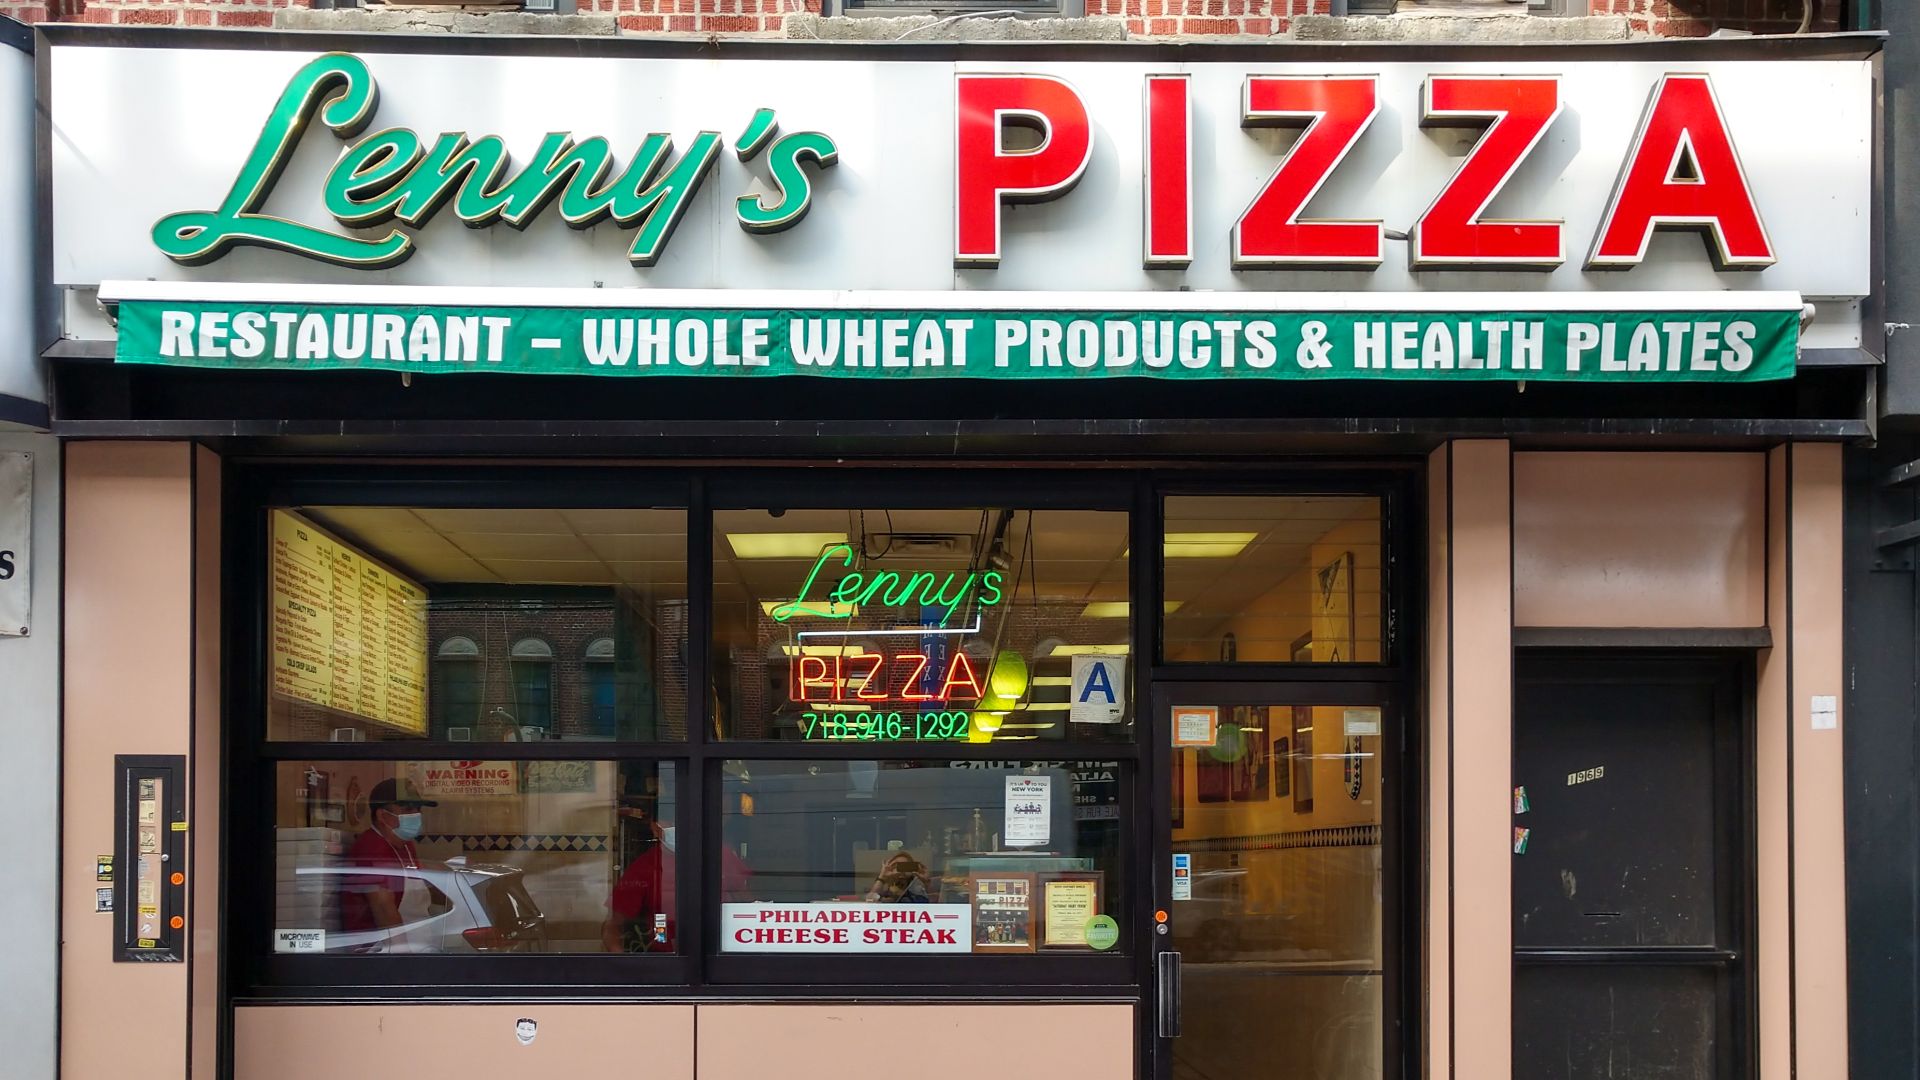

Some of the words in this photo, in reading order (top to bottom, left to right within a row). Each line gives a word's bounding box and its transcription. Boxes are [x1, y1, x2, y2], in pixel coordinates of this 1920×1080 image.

[149, 51, 839, 270] Lenny's
[953, 70, 1778, 268] PIZZA
[158, 310, 512, 363] RESTAURANT
[581, 317, 771, 367] WHOLE
[789, 318, 974, 367] WHEAT
[994, 318, 1278, 369] PRODUCTS
[1296, 320, 1334, 369] &
[1353, 320, 1545, 370] HEALTH
[1566, 320, 1757, 372] PLATES
[799, 652, 984, 700] PIZZA
[1079, 661, 1116, 704] A
[802, 711, 968, 740] 718-946-1292
[426, 769, 509, 780] WARNING
[1568, 767, 1603, 785] 1969
[426, 779, 448, 787] DIGITAL
[450, 779, 471, 787] VIDEO
[472, 779, 510, 787] RECORDING
[465, 786, 495, 794] SYSTEMS
[759, 910, 932, 923] PHILADELPHIA
[280, 933, 320, 941] MICROWAVE
[735, 928, 849, 944] CHEESE
[863, 928, 957, 944] STEAK
[298, 941, 313, 949] USE
